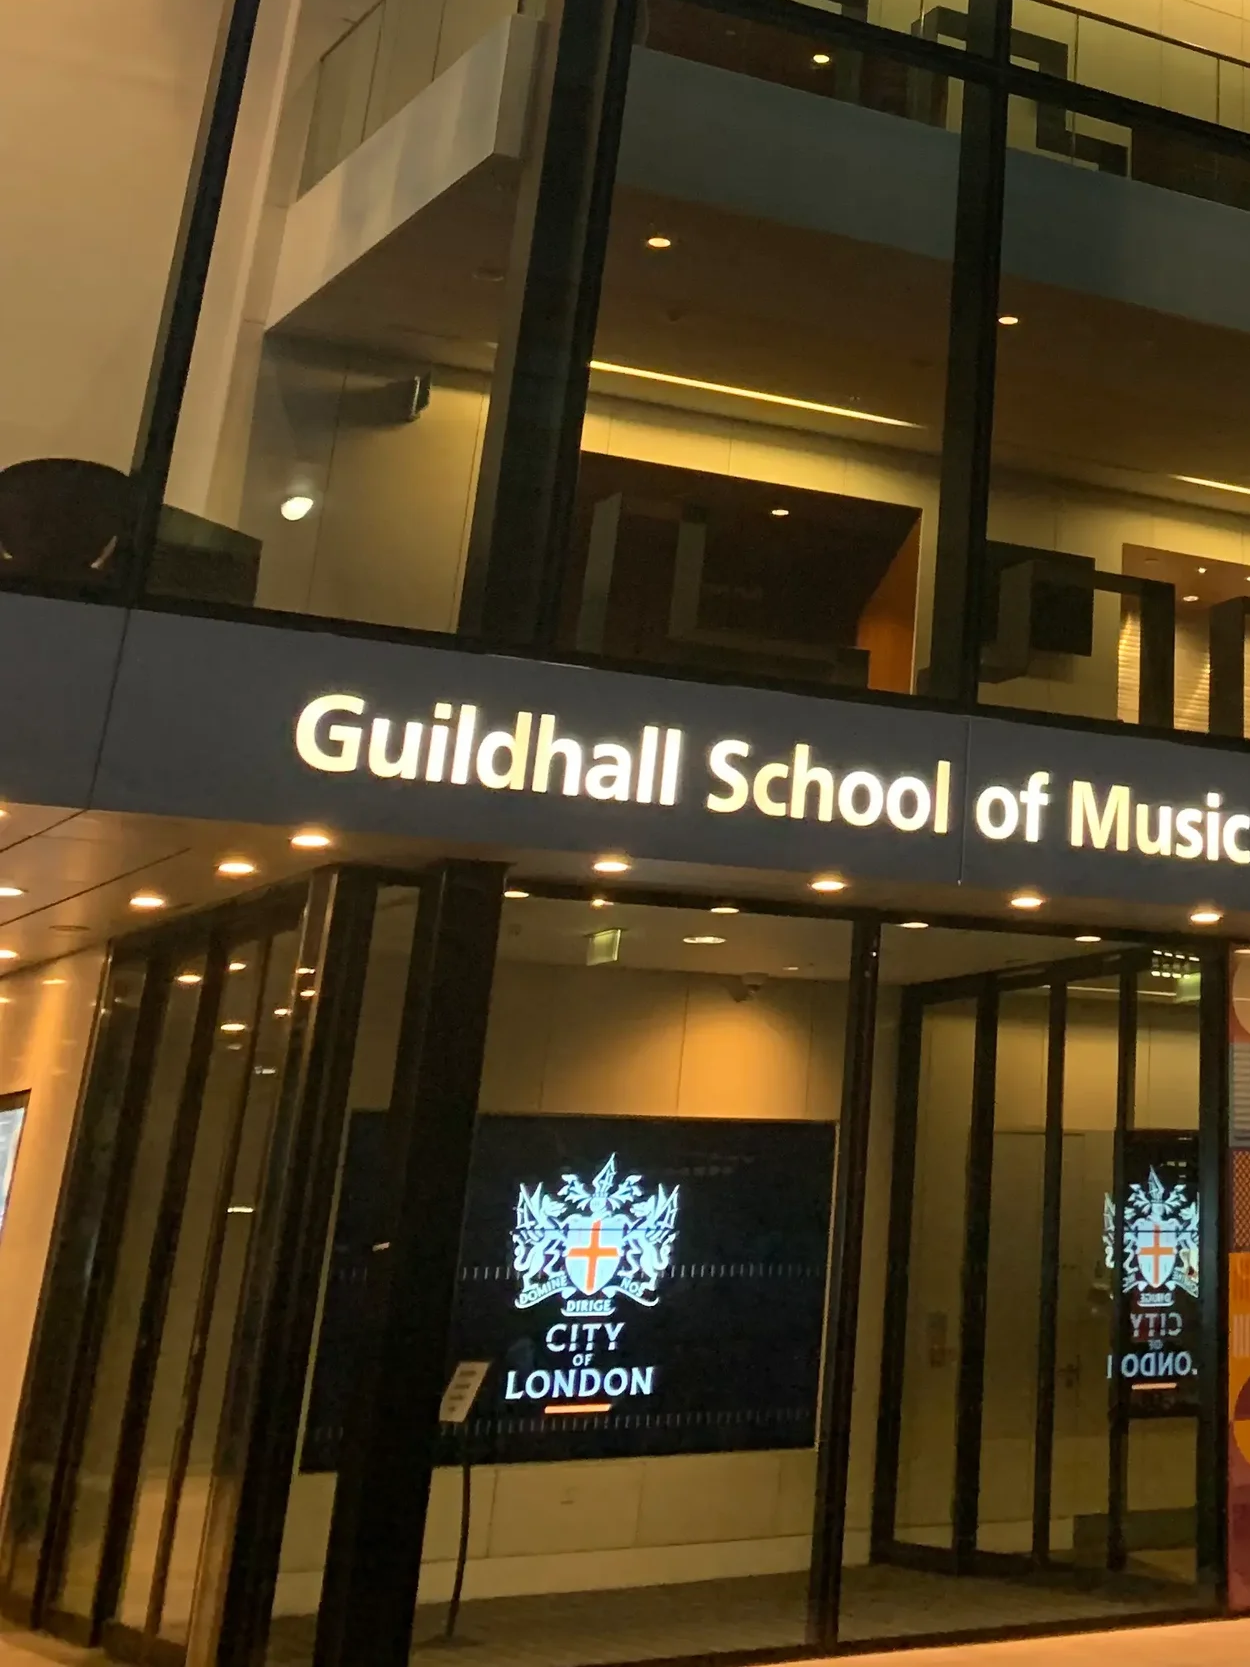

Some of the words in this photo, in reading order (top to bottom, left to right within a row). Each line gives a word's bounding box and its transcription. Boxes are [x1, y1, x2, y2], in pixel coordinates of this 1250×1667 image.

[296, 695, 682, 806] Guildhall
[706, 739, 951, 834] School
[975, 771, 1050, 843] of
[1070, 780, 1250, 864] Music
[519, 1275, 568, 1305] DOMINE
[566, 1299, 612, 1312] DIRIGE
[545, 1322, 625, 1352] CITY
[572, 1353, 594, 1367] OF
[505, 1366, 655, 1400] LONDON
